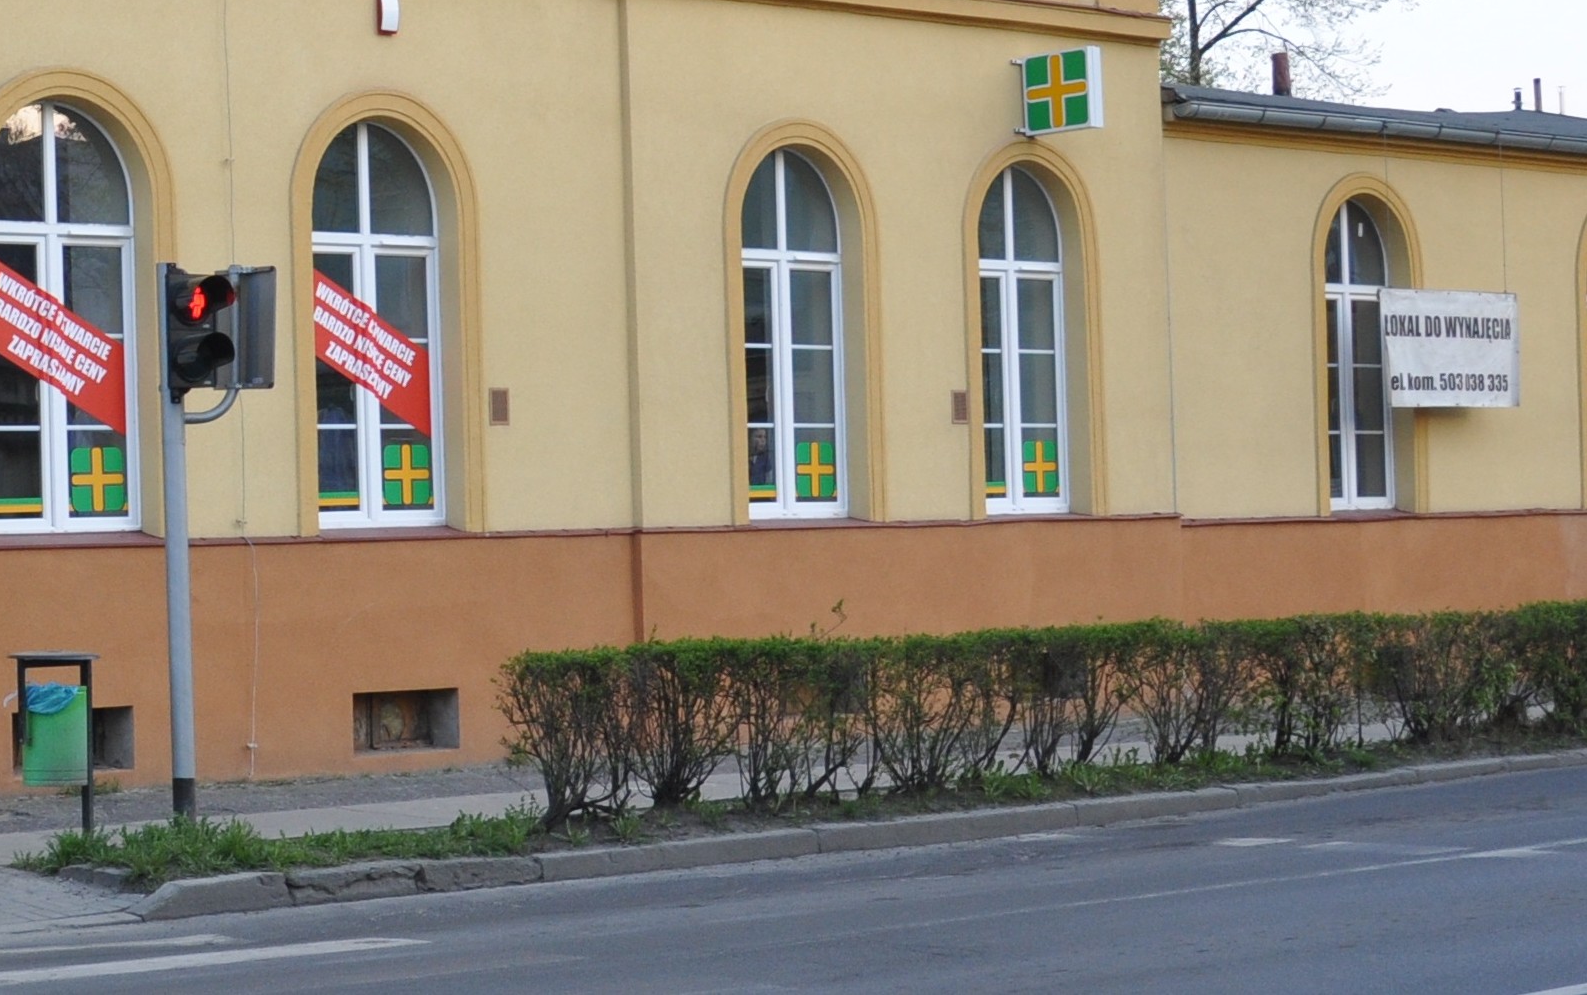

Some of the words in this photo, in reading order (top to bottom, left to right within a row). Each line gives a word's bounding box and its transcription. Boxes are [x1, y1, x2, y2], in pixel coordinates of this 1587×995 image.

[315, 281, 371, 329] WKRÓTCE
[1384, 314, 1421, 337] LOKAL
[1425, 316, 1442, 338] DO
[1445, 316, 1511, 343] WYNAJĘCIA
[313, 305, 356, 346] BARDZO
[383, 359, 412, 389] CENY
[75, 352, 108, 384] CENY
[1408, 373, 1437, 391] kom.
[1440, 373, 1464, 391] 503
[1487, 374, 1509, 392] 335
